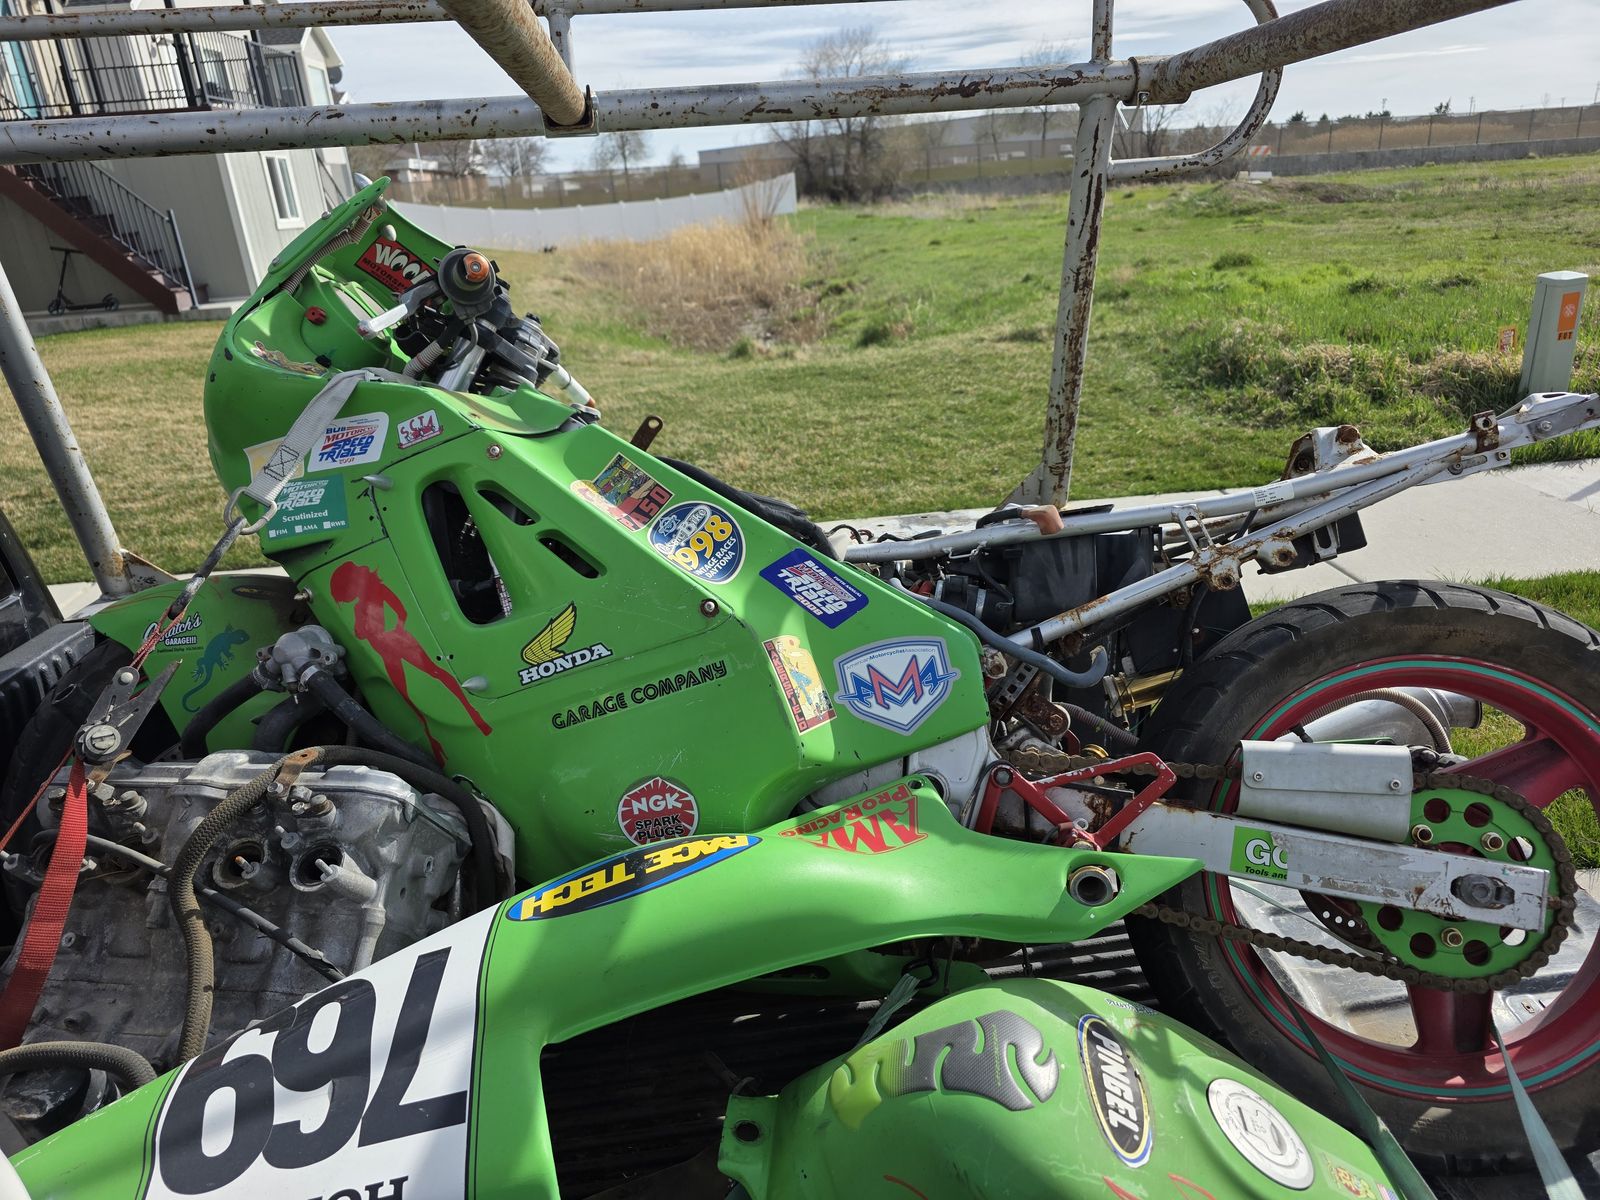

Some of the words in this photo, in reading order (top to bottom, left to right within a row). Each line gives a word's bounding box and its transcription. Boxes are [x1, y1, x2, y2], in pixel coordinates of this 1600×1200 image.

[400, 415, 433, 437] SCTA
[331, 436, 374, 449] SPEED
[289, 489, 325, 499] SPEED
[282, 510, 328, 523] Scrutinized
[668, 515, 732, 571] 1998
[715, 537, 736, 559] RACES
[705, 551, 735, 578] DAYTONA
[793, 594, 823, 616] 2008
[800, 573, 848, 612] SPEED
[519, 643, 612, 685] HONDA
[552, 692, 628, 729] GARAGE
[631, 660, 727, 704] COMPANY
[765, 641, 808, 731] BAKERSFIELD
[838, 654, 957, 710] AMA
[631, 792, 682, 815] NGK
[635, 813, 682, 830] SPARK
[637, 825, 684, 841] PLUGS
[644, 835, 748, 874] RACE
[1245, 865, 1269, 877] Tools
[521, 865, 635, 921] TECH
[159, 946, 468, 1195] 769
[1092, 1030, 1139, 1132] PINGEL
